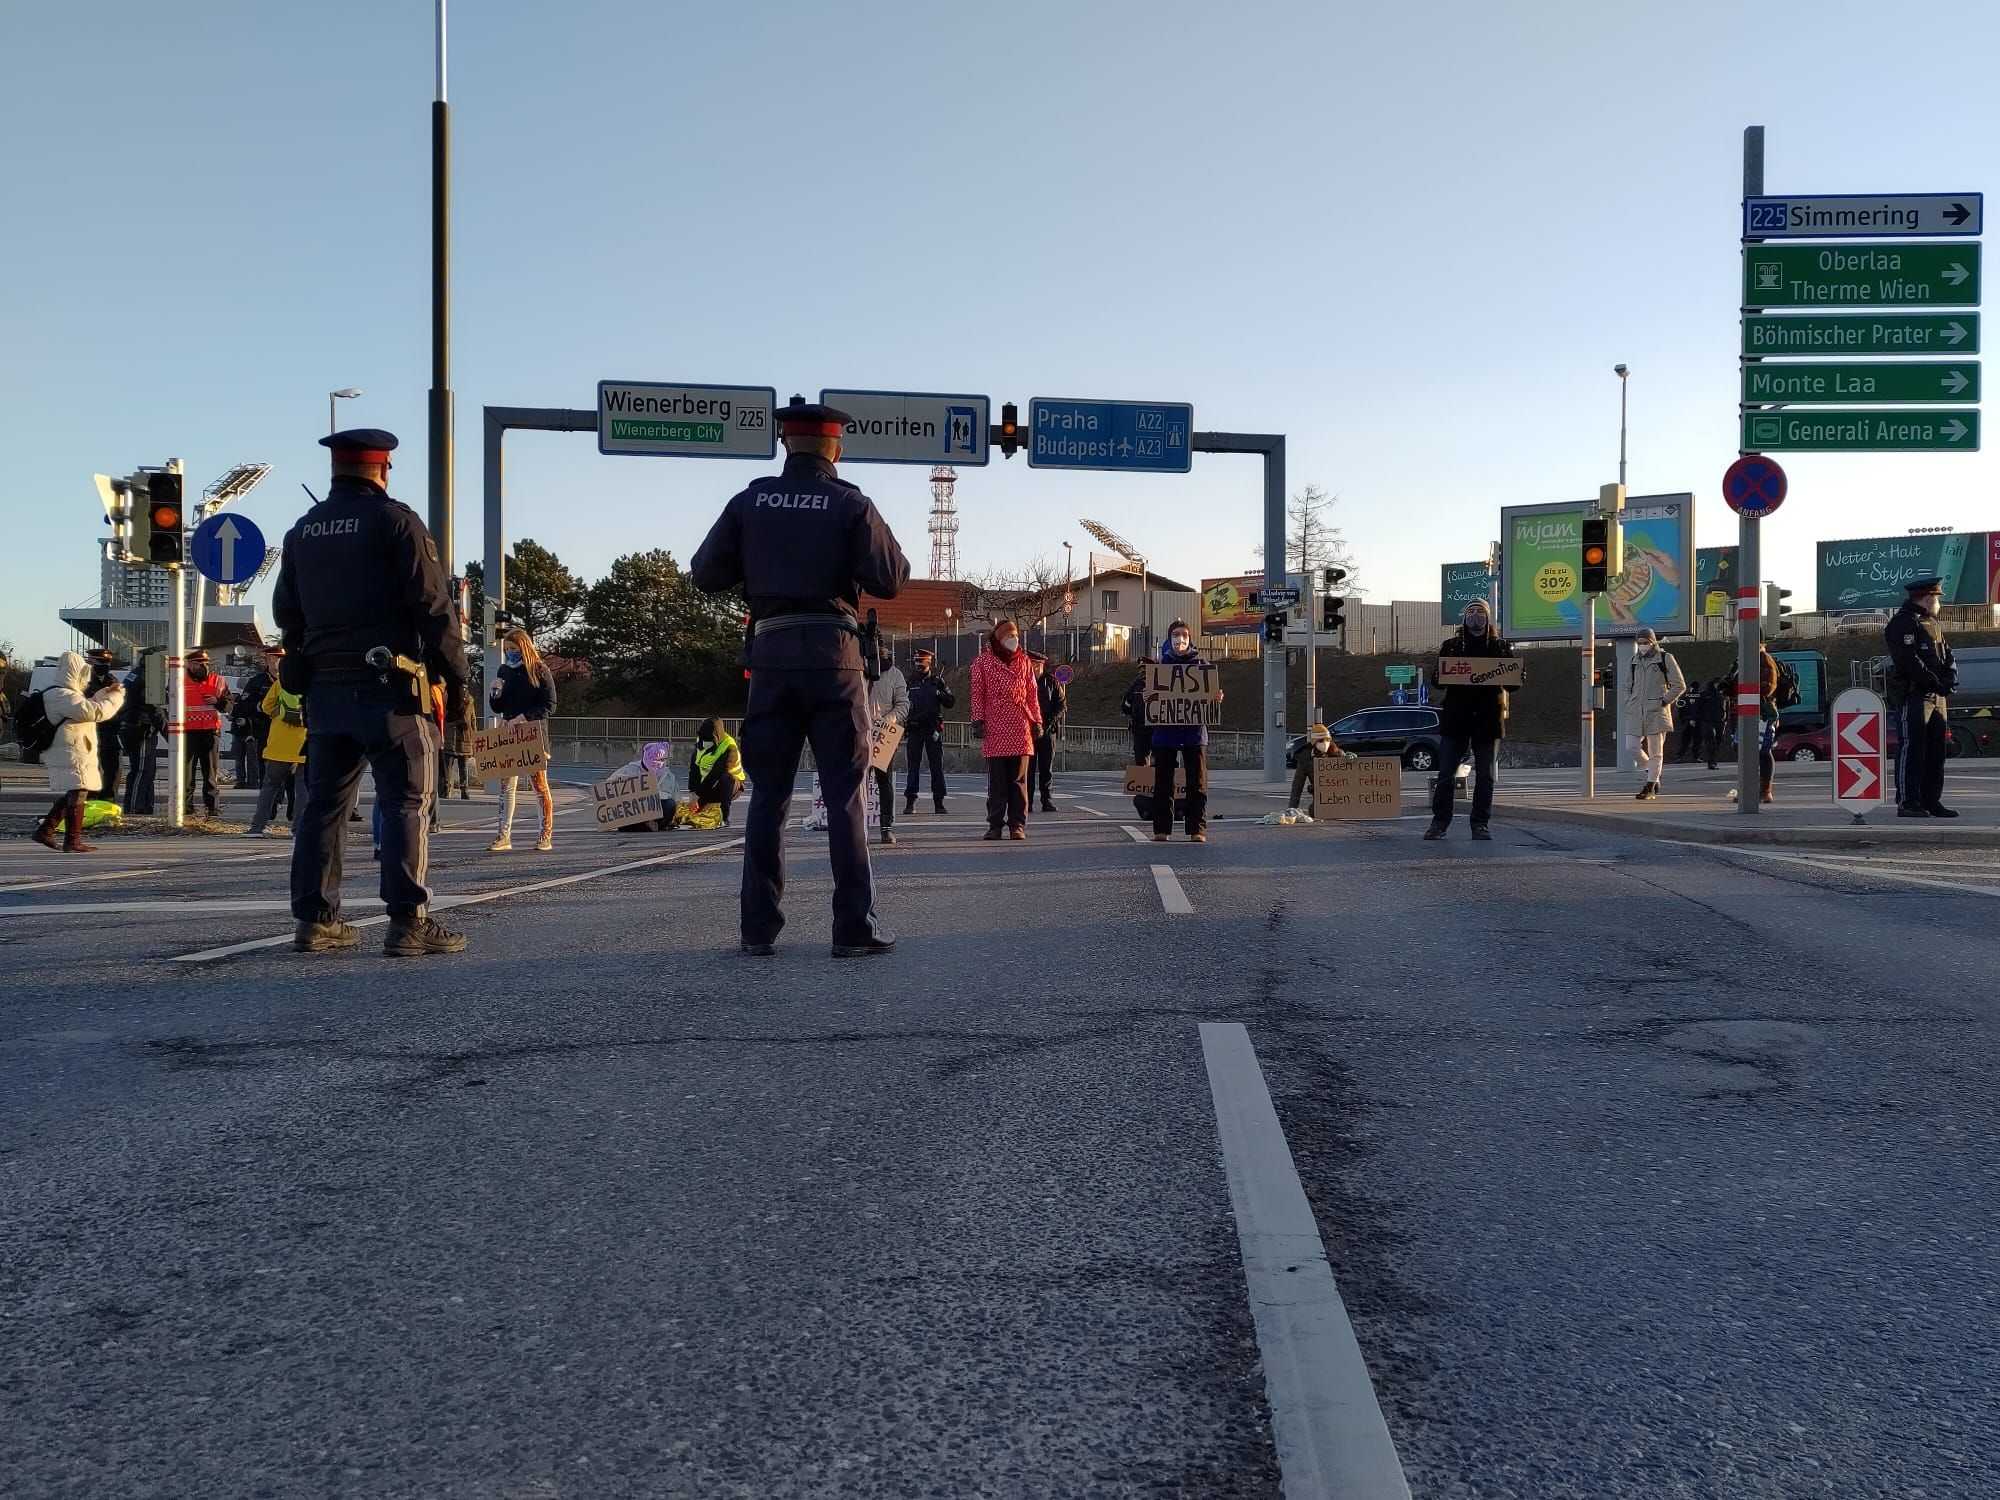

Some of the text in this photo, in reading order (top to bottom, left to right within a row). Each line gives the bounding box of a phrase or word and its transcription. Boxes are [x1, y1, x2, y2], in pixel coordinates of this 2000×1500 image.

[1752, 204, 1919, 230] 225 Simmering
[1819, 251, 1901, 271] Oberlaa
[1790, 279, 1930, 300] Therme Wien
[1753, 324, 1932, 345] Böhmischer Prater
[1753, 373, 1875, 393] Monte Laa
[604, 390, 764, 428] Wienerberg 225
[1037, 408, 1162, 430] Praha A22
[614, 422, 721, 442] Wienerberg City
[845, 416, 935, 437] avoriten
[1788, 420, 1933, 441] Generali Arena
[1037, 434, 1161, 461] Budapest A23
[755, 492, 829, 510] POLIZEI
[1737, 505, 1772, 517] ANFANG
[302, 518, 359, 538] POLIZEI
[1516, 520, 1577, 546] mjam
[1890, 543, 1922, 559] Halt
[1540, 577, 1571, 589] 30%
[1870, 562, 1915, 586] Style
[1153, 665, 1217, 693] LAST
[1441, 660, 1520, 684] Letzte Generation
[1145, 693, 1219, 724] GENERATION
[475, 734, 515, 752] #Lobau
[479, 749, 541, 771] sind wir alle
[1318, 759, 1393, 772] Böden retten
[594, 774, 650, 801] LETZTE
[1318, 774, 1391, 787] Essen retten
[597, 793, 662, 823] GENERATION
[1319, 791, 1392, 805] Leben retten
